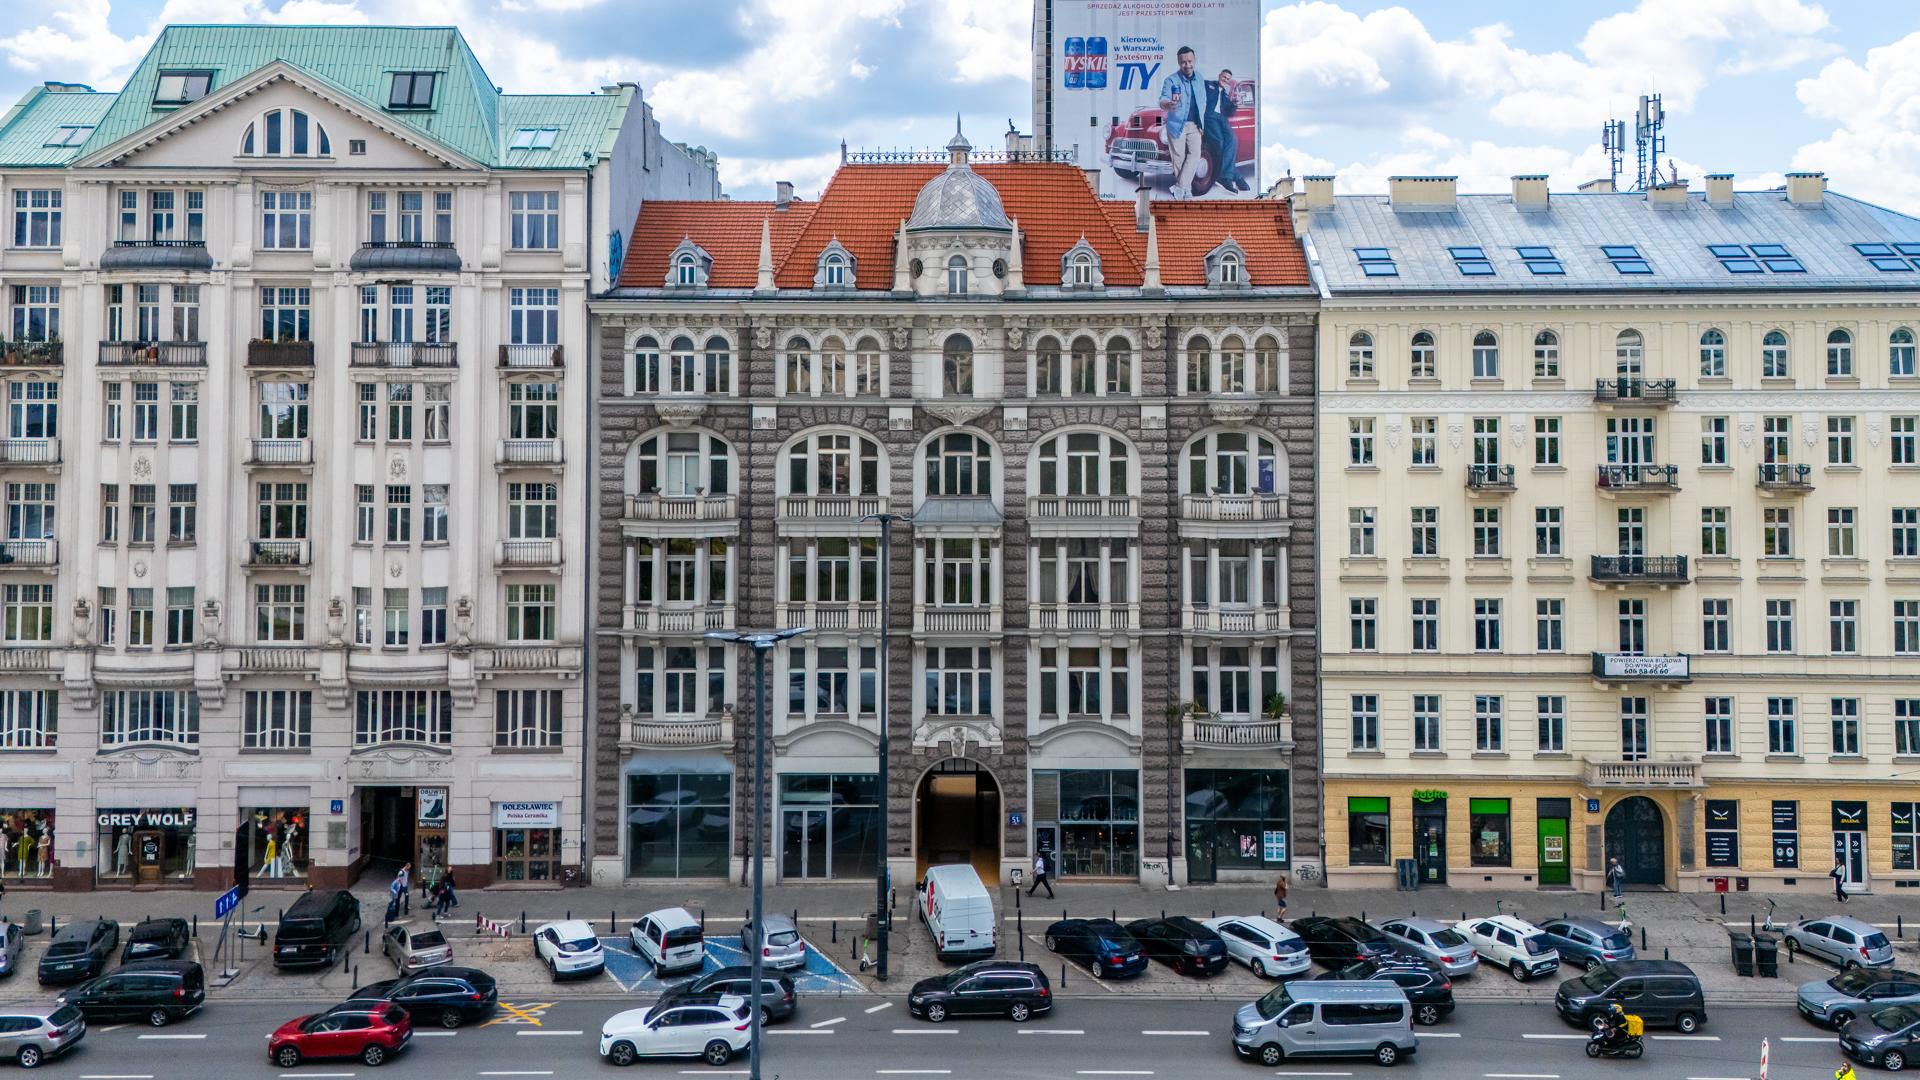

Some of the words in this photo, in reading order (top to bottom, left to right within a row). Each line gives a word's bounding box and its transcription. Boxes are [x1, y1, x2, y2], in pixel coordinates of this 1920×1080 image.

[1123, 44, 1165, 52] Warszawie
[98, 814, 142, 826] GREY
[146, 814, 193, 826] WOLF
